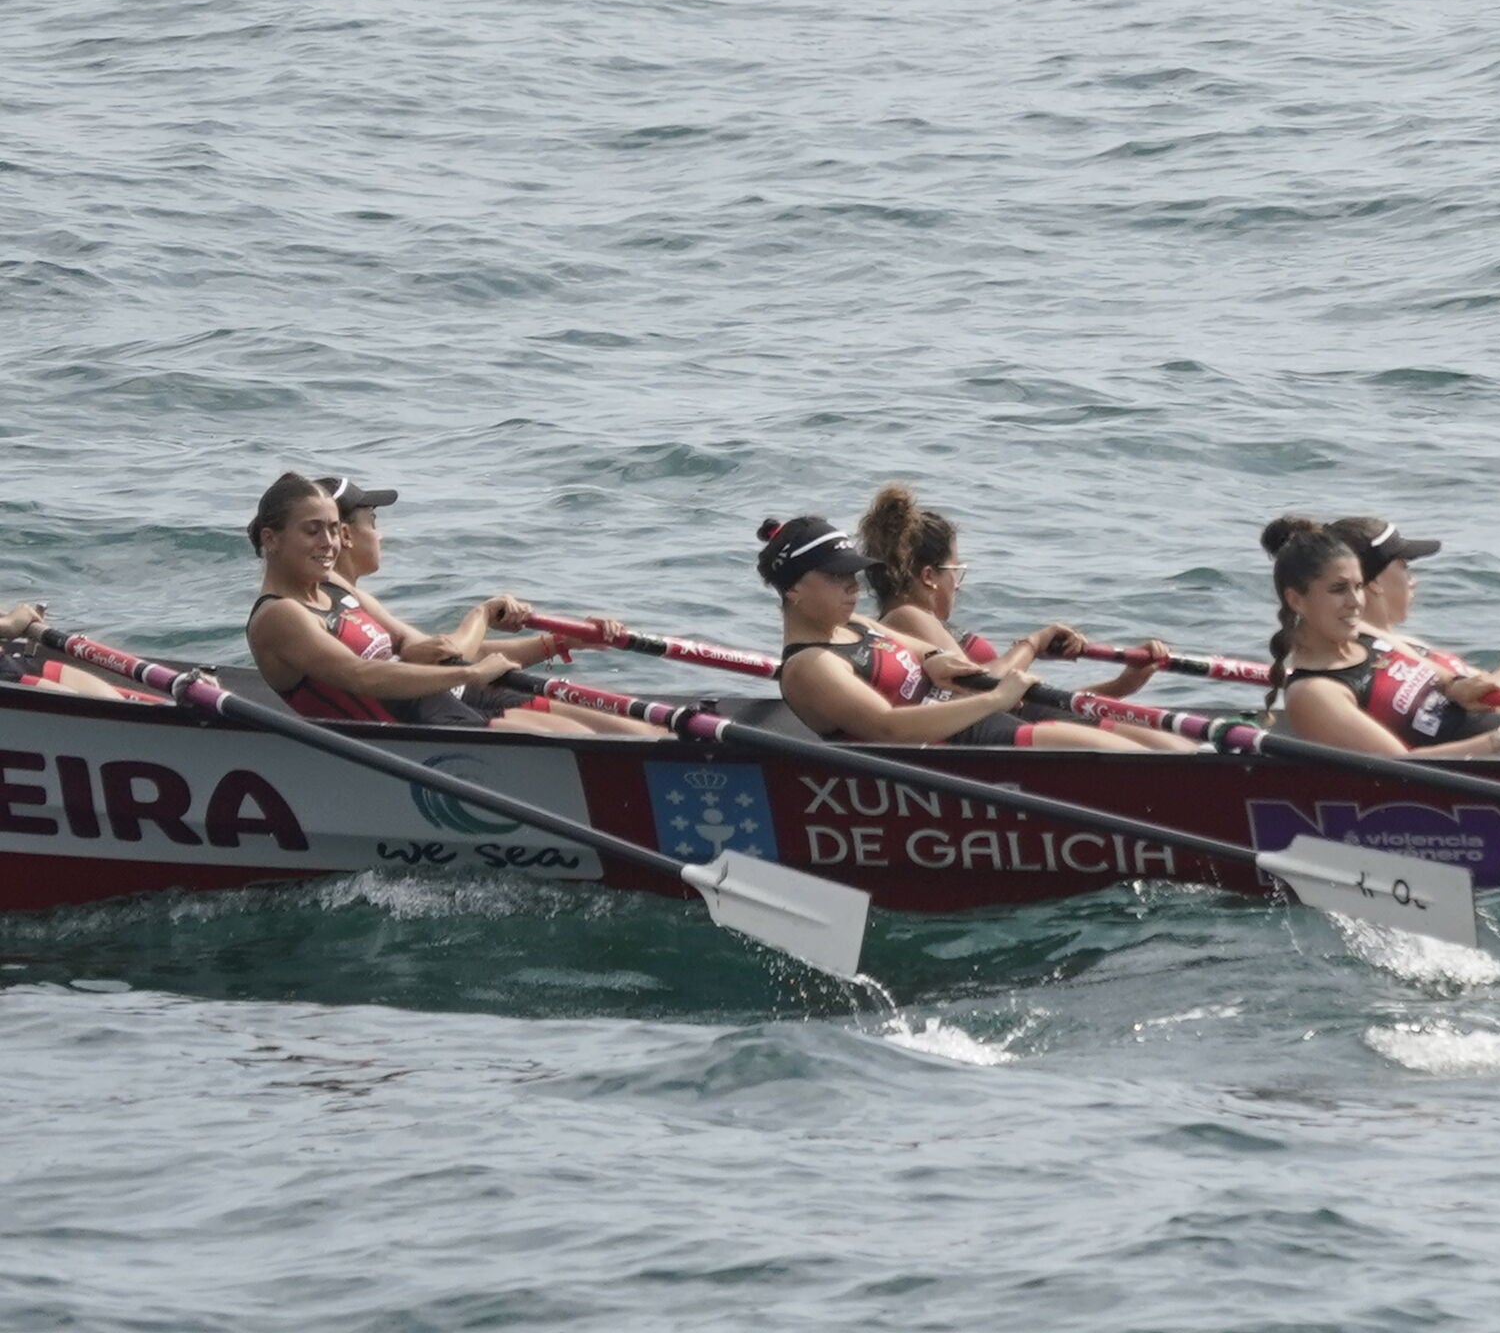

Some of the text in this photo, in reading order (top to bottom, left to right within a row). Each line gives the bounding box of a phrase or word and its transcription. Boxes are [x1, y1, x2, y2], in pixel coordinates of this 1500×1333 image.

[805, 826, 1177, 875] DE GALICIA
[1365, 832, 1486, 848] violencia
